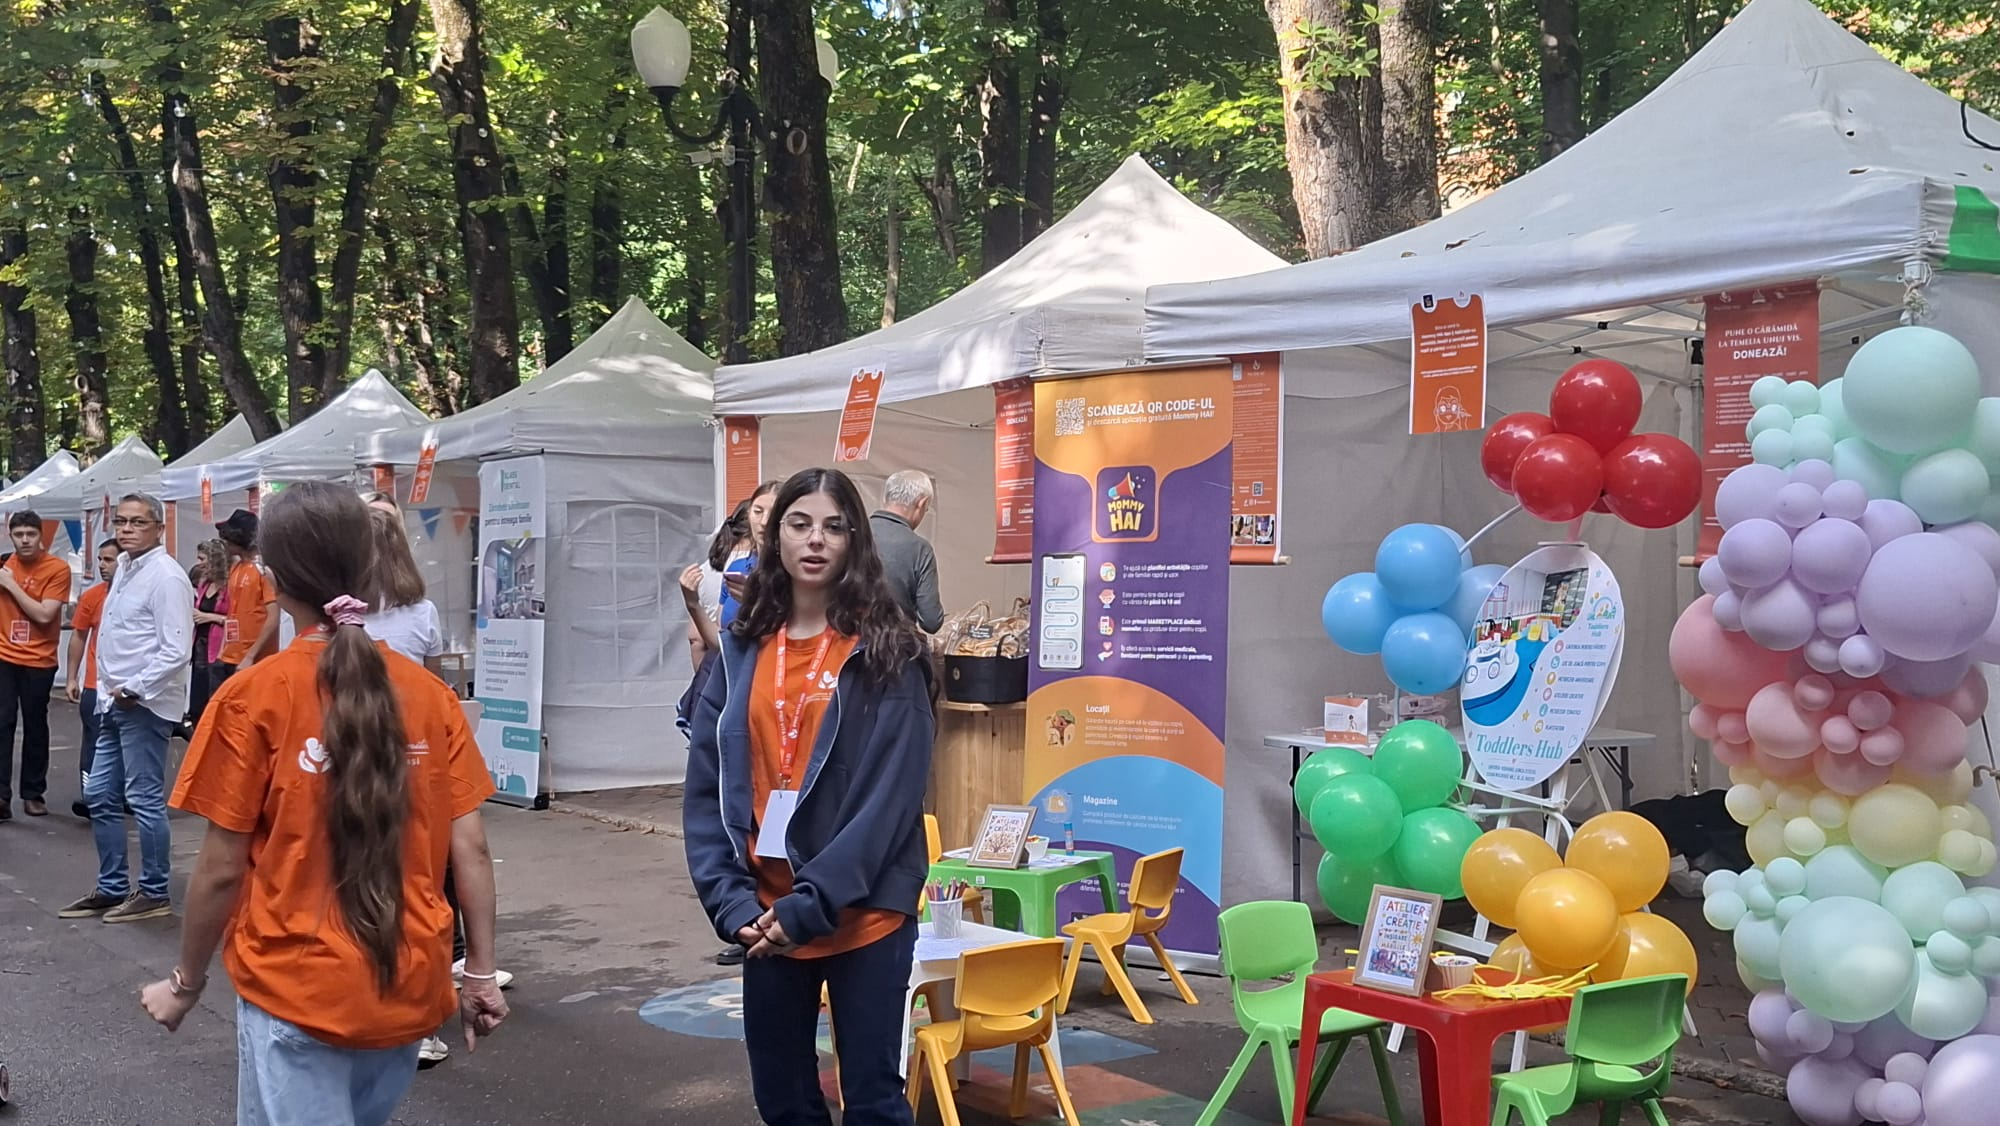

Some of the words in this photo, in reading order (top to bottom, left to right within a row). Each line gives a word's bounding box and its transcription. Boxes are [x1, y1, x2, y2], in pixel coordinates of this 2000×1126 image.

[1730, 338, 1760, 347] TEMELIA
[1734, 346, 1786, 360] DONEAZĂ!
[1088, 401, 1144, 417] SCANEAZĂ
[1148, 401, 1162, 413] QR
[1166, 398, 1214, 412] CODE-UL
[1173, 412, 1198, 420] Mommy
[1108, 499, 1145, 512] MOMMY
[1110, 510, 1141, 532] HAI
[1086, 704, 1110, 715] Locații
[1476, 734, 1534, 757] Toddlers
[1535, 740, 1563, 760] Hub
[1083, 795, 1117, 806] Magazine
[1386, 900, 1426, 917] ATELIER
